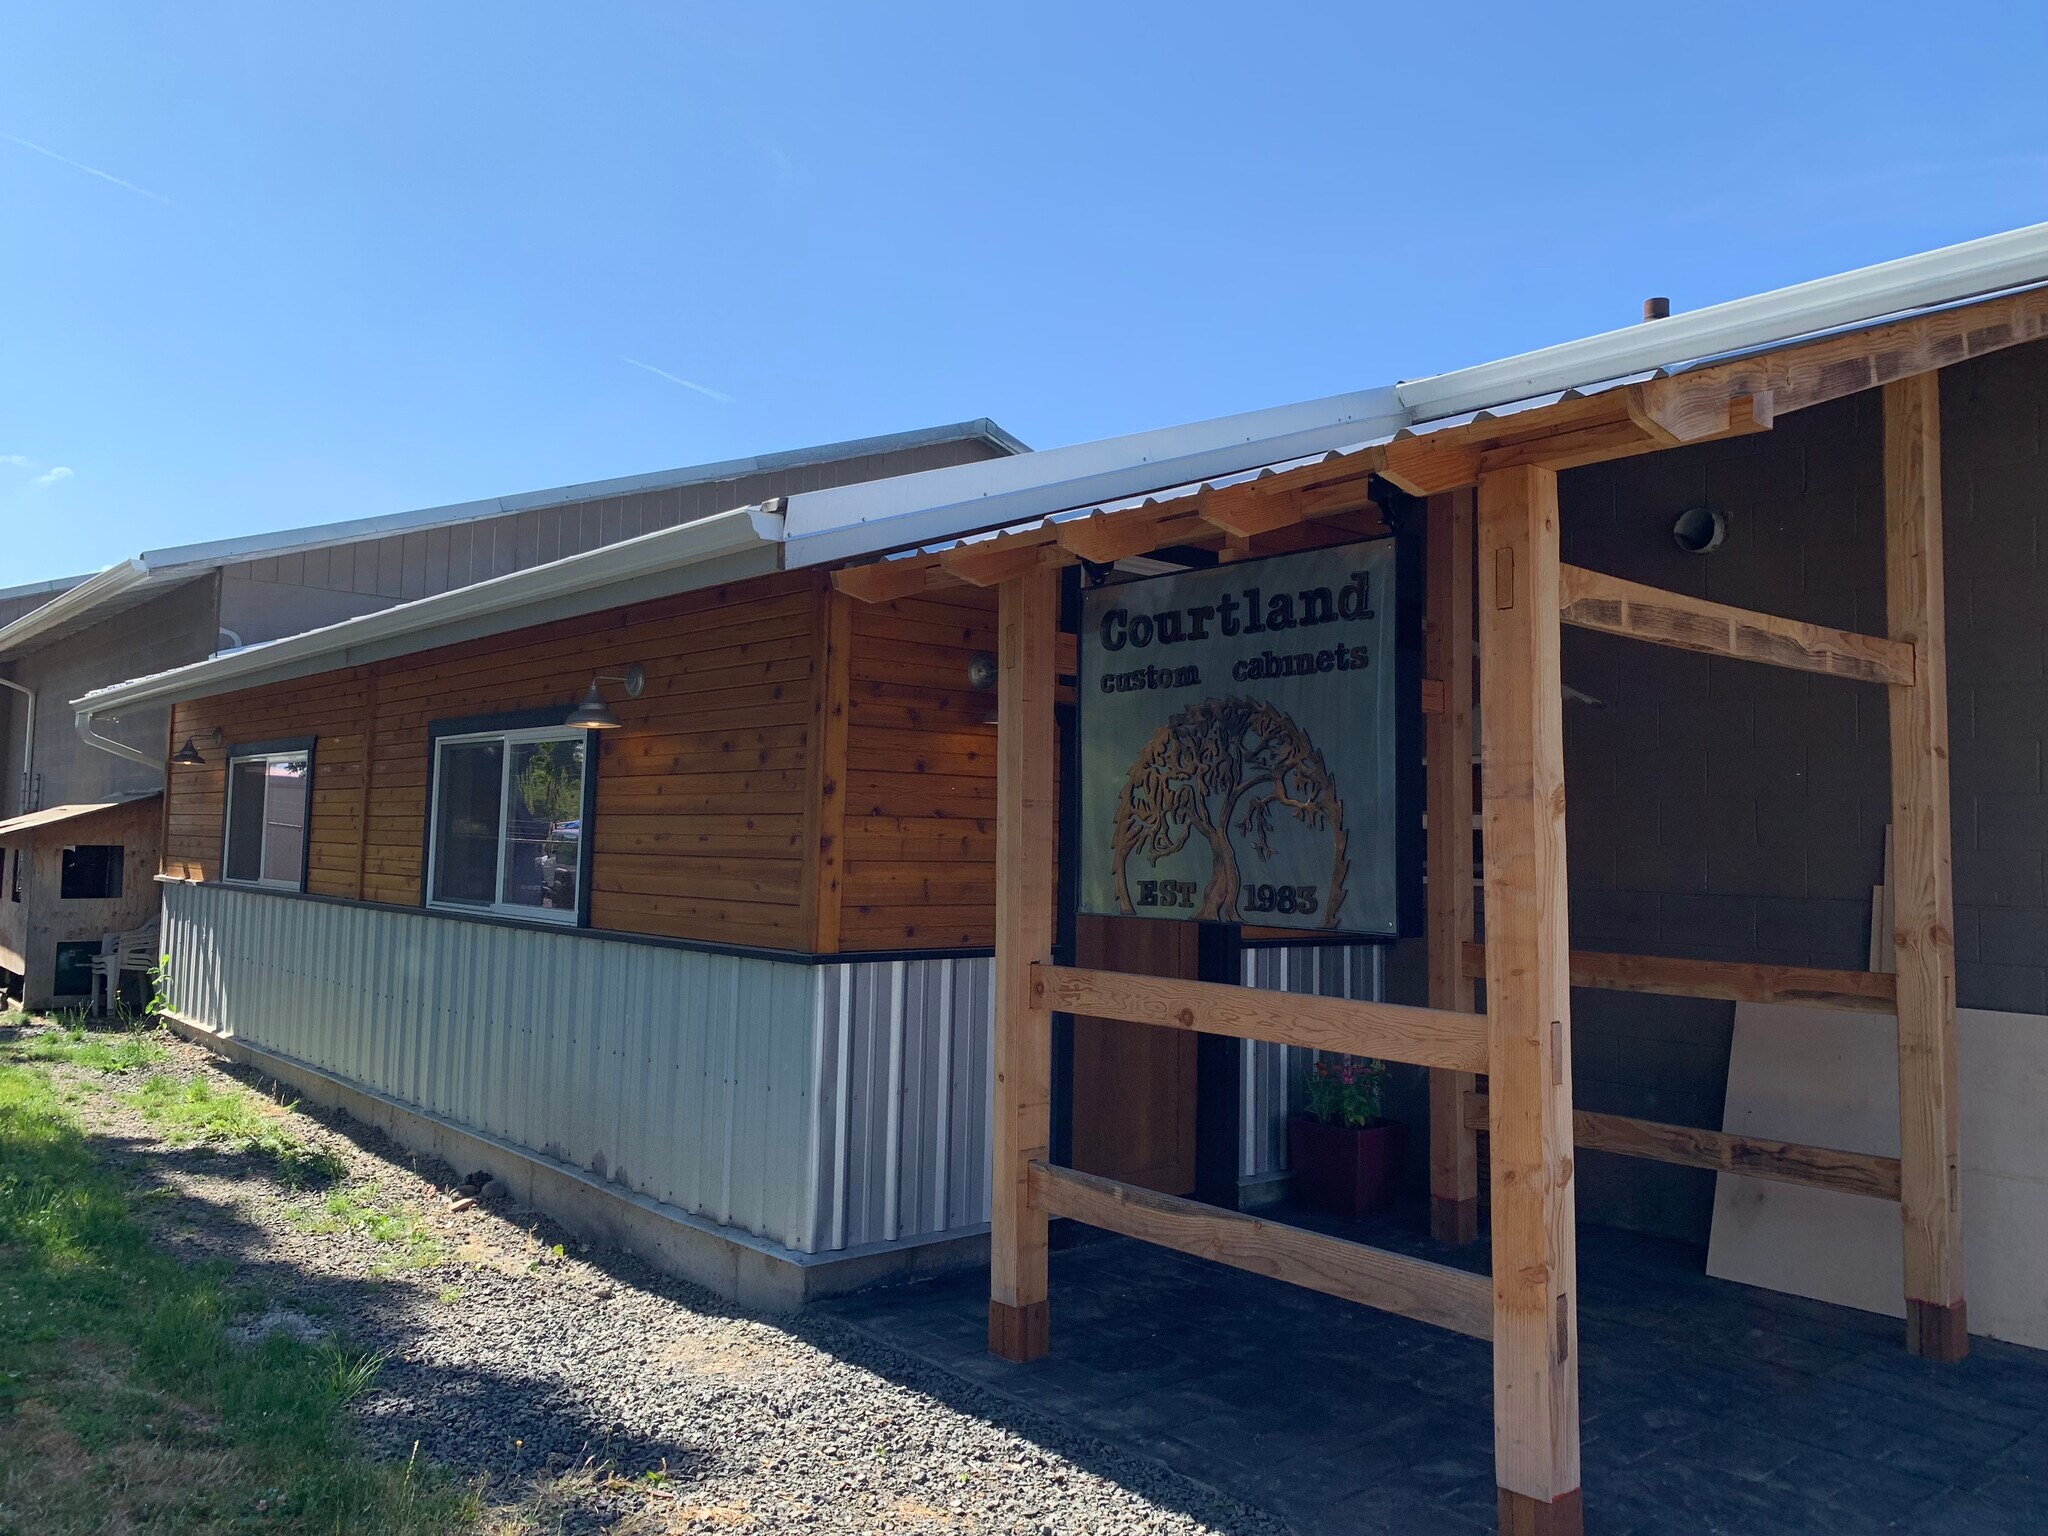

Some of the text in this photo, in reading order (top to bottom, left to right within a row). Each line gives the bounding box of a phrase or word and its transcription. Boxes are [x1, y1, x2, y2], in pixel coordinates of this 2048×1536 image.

[1100, 570, 1374, 651] Courtland
[1100, 643, 1369, 693] custom cabinets
[1136, 879, 1318, 914] EST 1983
